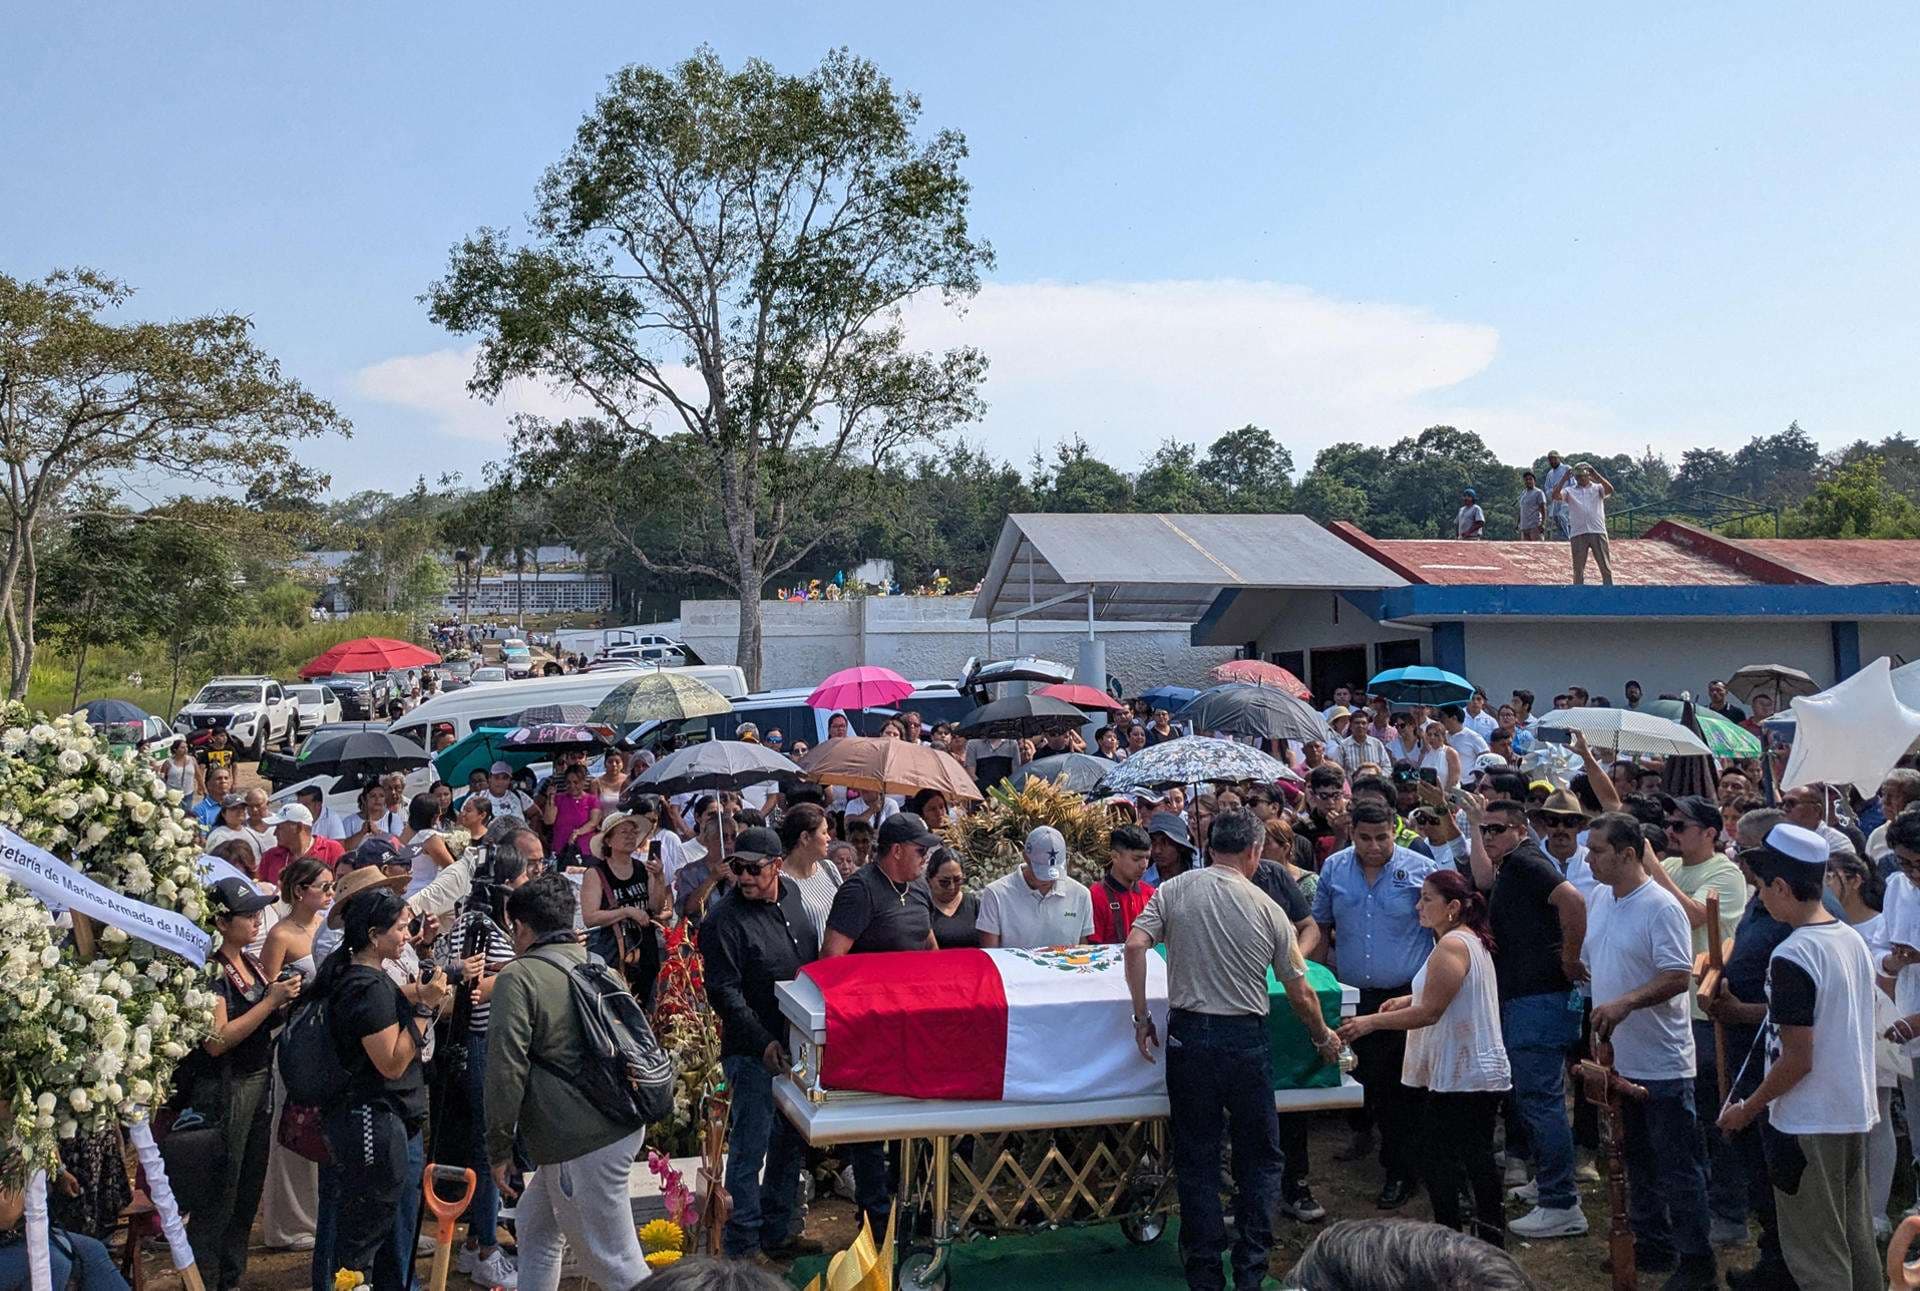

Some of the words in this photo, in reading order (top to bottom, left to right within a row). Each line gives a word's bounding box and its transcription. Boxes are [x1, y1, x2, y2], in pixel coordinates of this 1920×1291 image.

[44, 867, 60, 884] de
[62, 876, 154, 926] Marina-Armada
[157, 919, 172, 933] de
